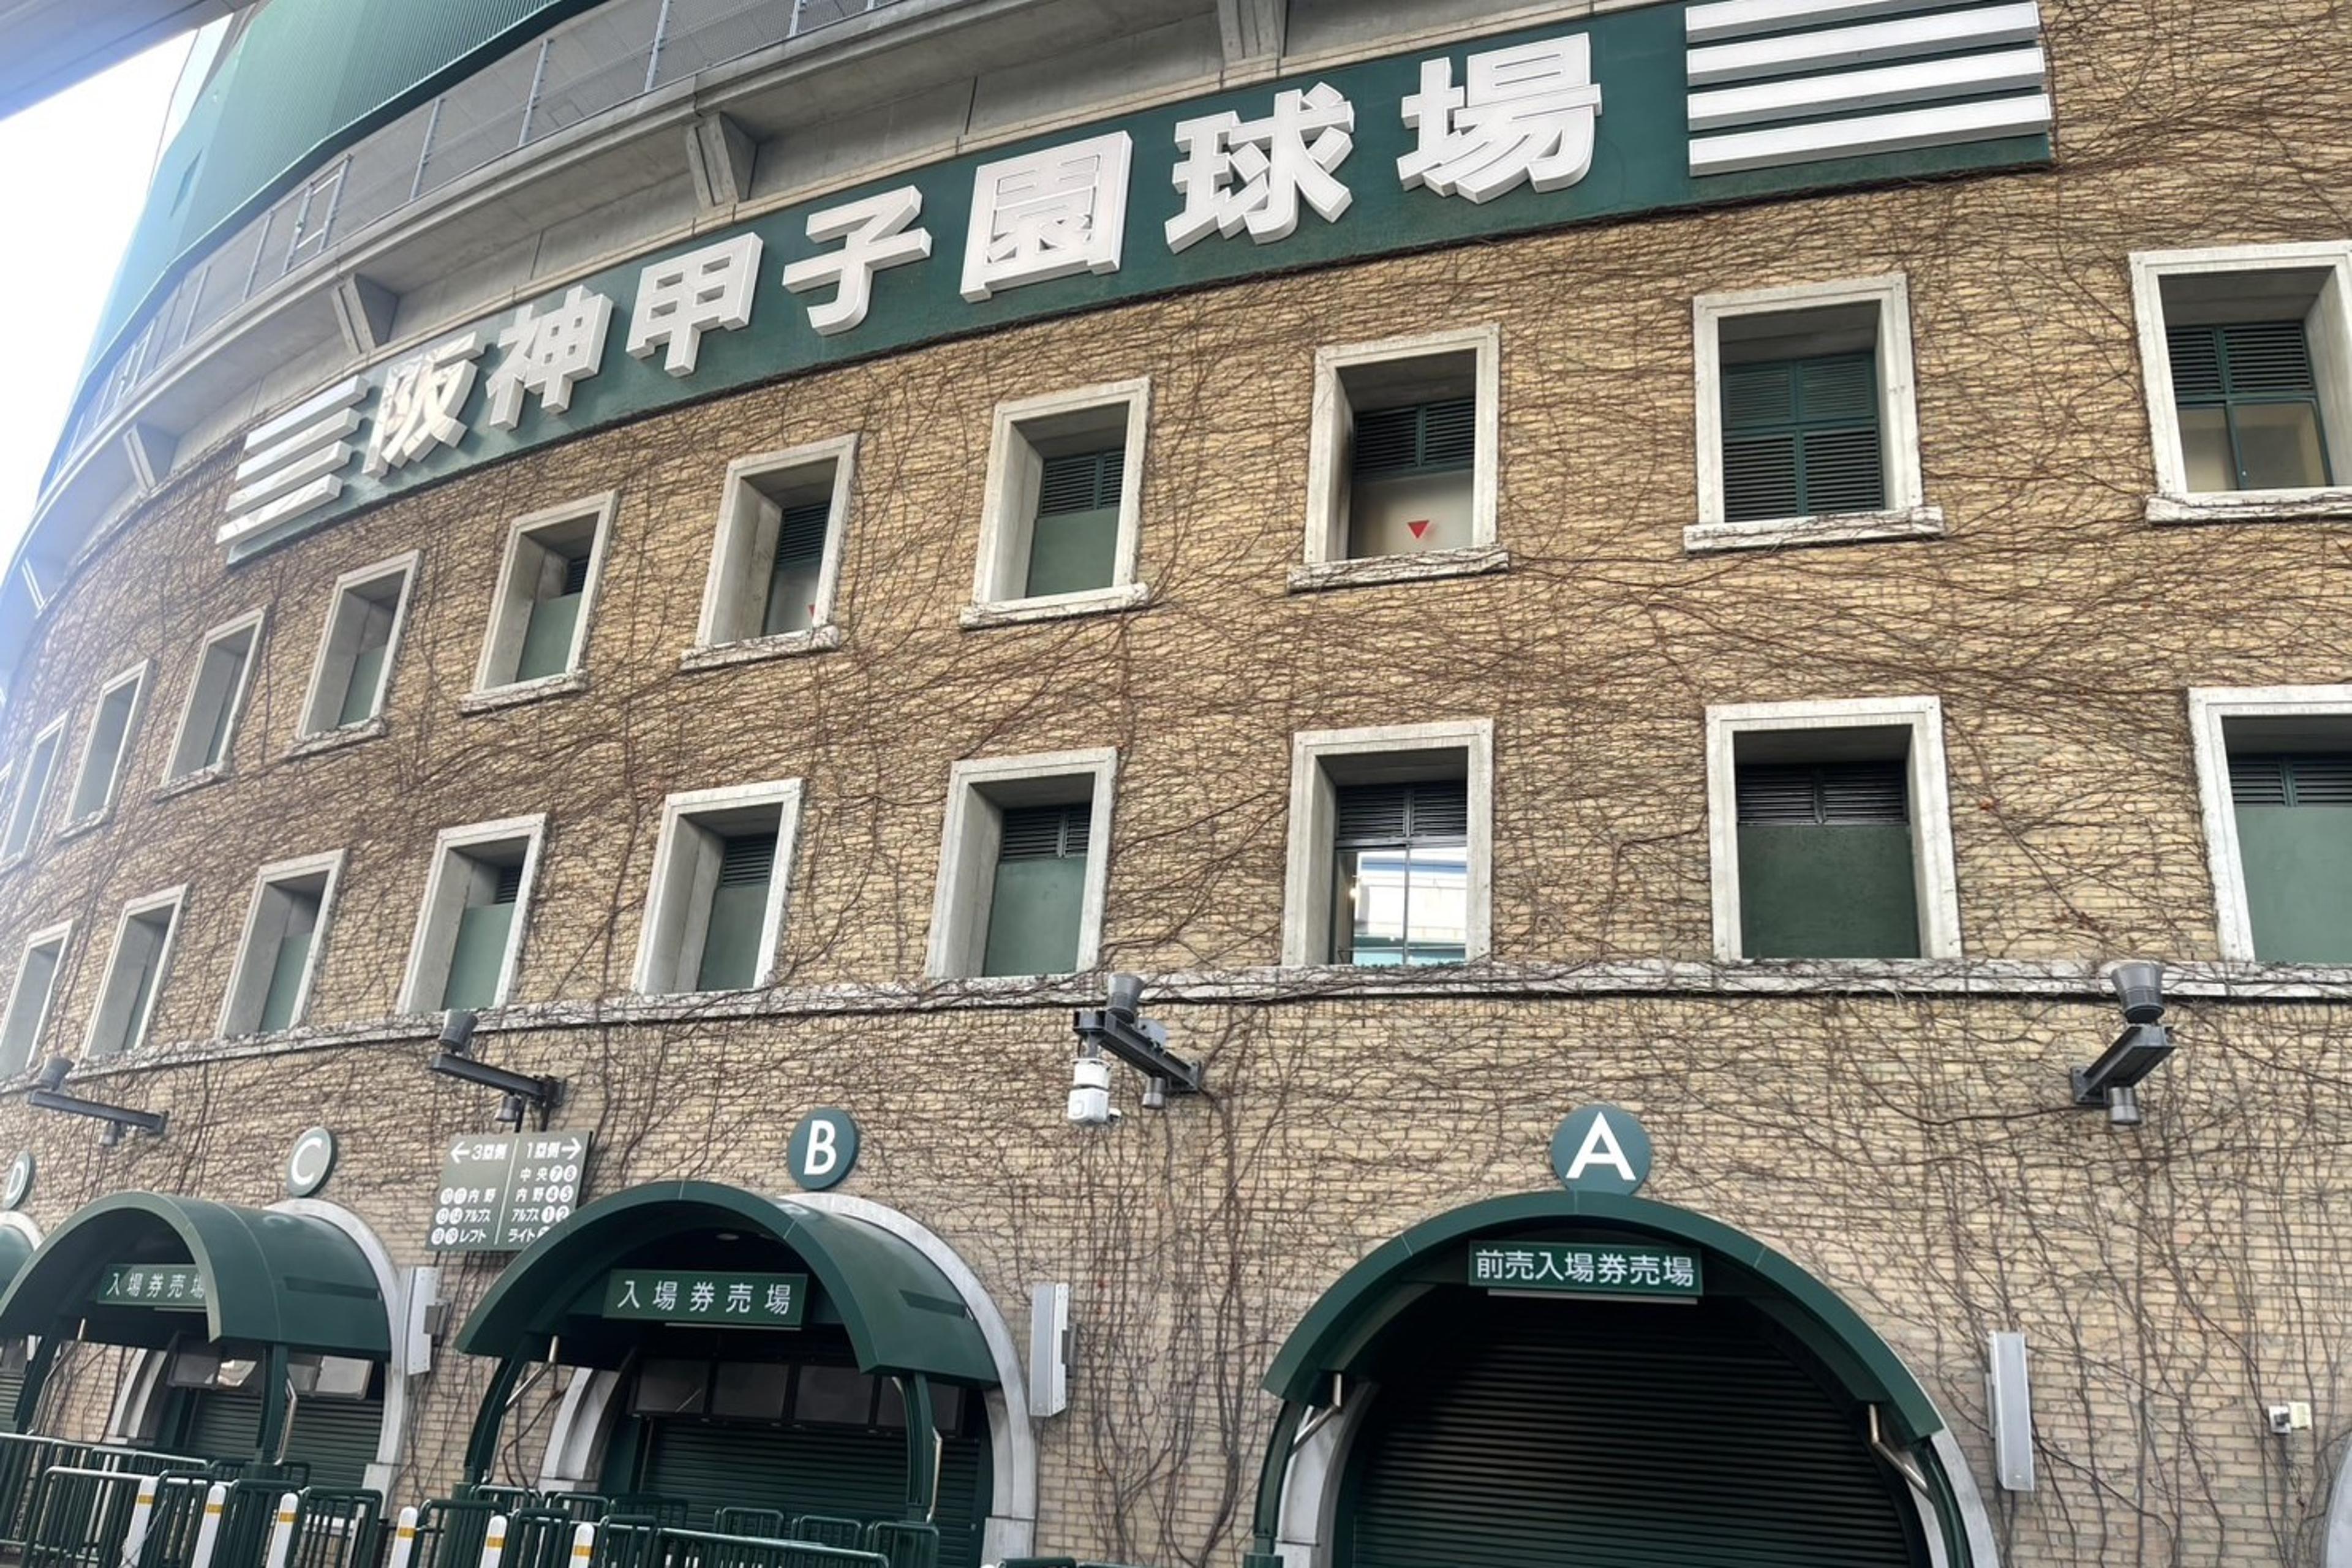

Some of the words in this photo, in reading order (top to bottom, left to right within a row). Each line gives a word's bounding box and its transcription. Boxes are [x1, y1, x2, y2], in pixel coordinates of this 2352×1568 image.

[361, 32, 1602, 481] 阪神甲子園球場
[291, 1137, 322, 1185] C
[804, 1120, 837, 1176] B
[1565, 1111, 1637, 1181] A
[6, 1161, 25, 1199] D
[459, 1229, 487, 1244] レフト
[508, 1228, 535, 1243] ライト
[1476, 1249, 1695, 1287] 前売入場券売場
[617, 1280, 791, 1315] 入場券売場
